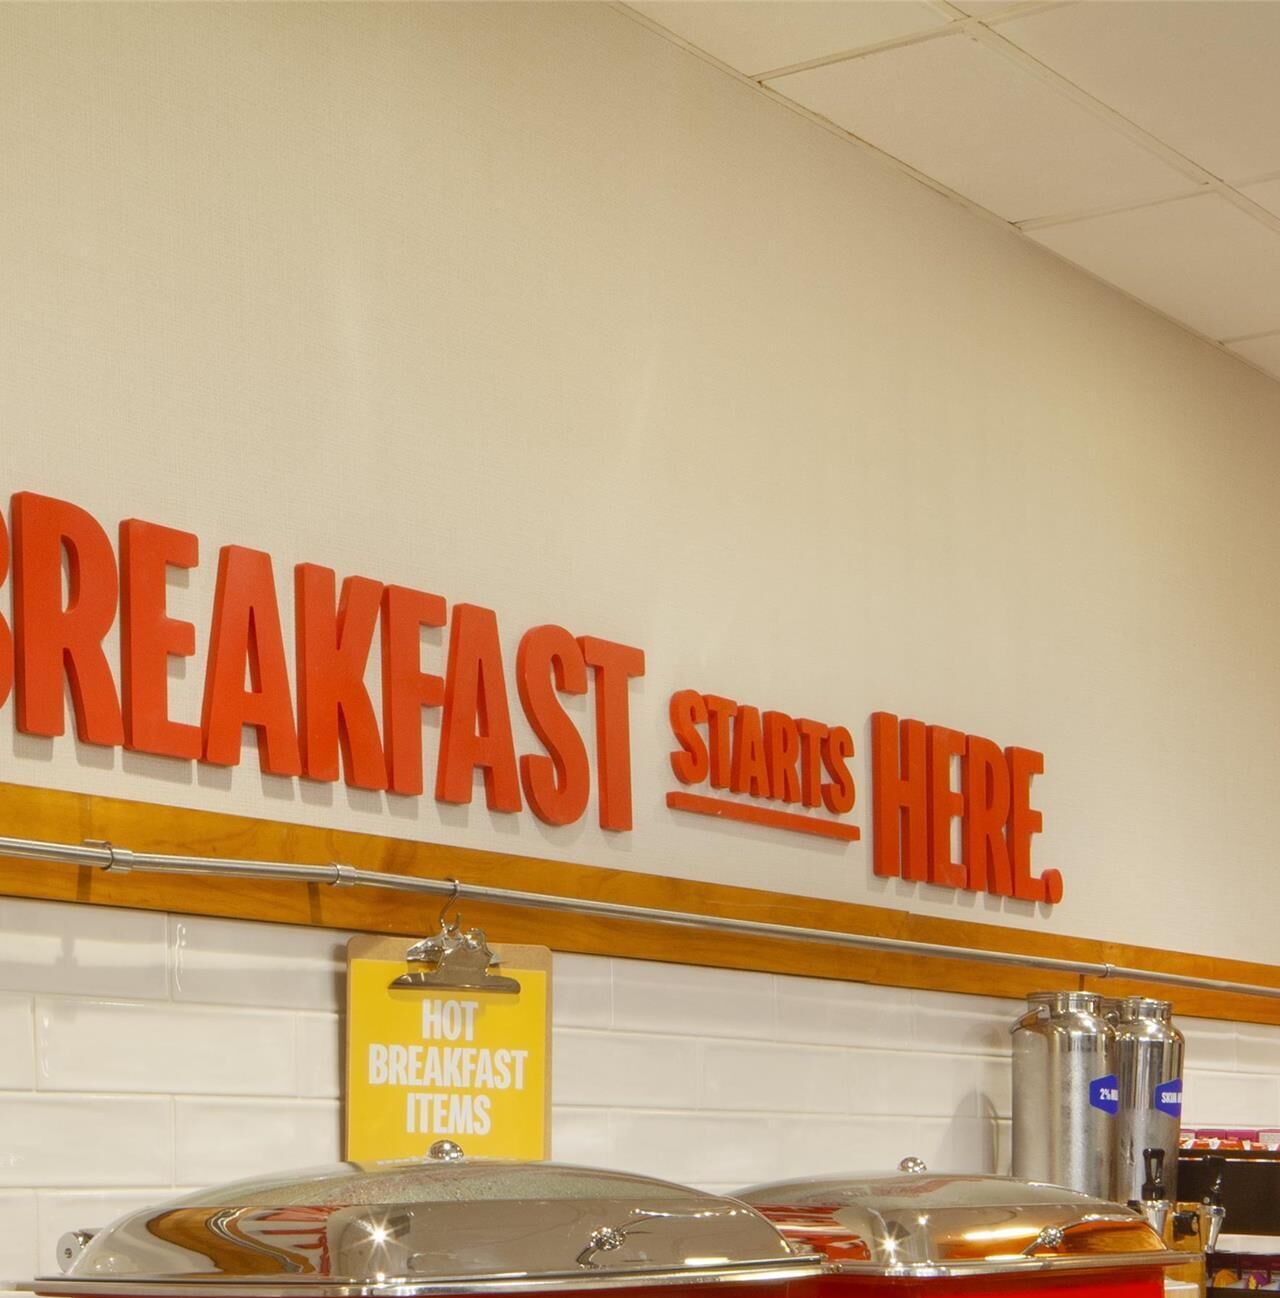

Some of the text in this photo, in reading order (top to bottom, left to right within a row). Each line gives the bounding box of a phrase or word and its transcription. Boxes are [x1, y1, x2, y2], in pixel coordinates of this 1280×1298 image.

[670, 689, 855, 814] STARTS
[871, 711, 1063, 904] HERE.
[422, 998, 479, 1041] HOT
[368, 1043, 528, 1090] BREAKFAST
[406, 1093, 491, 1136] ITEMS
